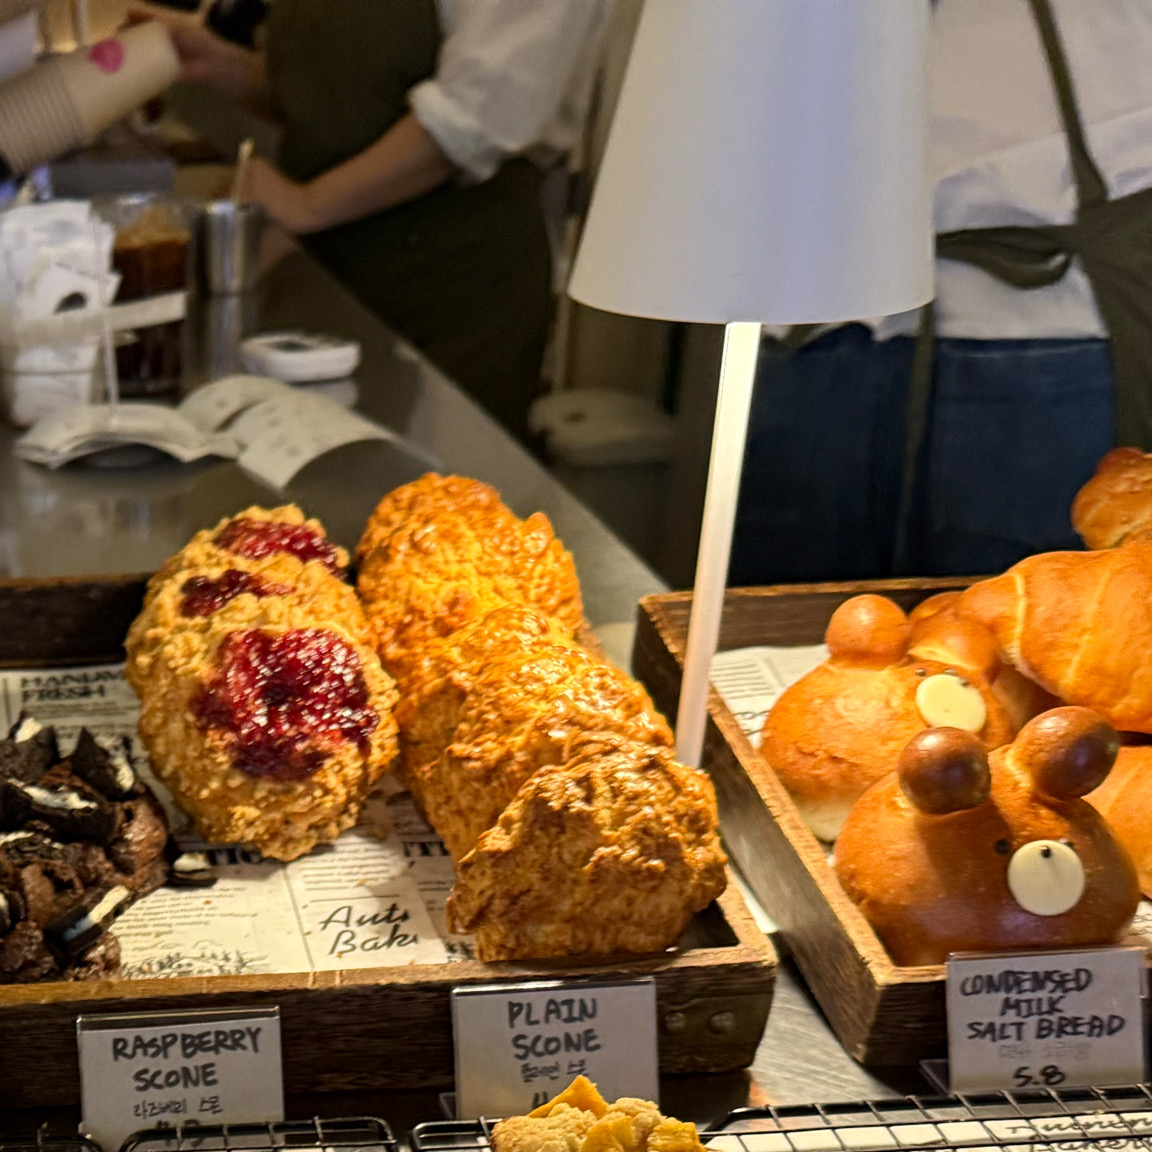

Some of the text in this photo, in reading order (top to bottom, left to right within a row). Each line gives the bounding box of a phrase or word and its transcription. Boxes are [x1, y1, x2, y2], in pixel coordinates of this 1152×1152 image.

[960, 968, 1092, 996] CONDENSED
[508, 998, 597, 1029] PLAIN
[1000, 996, 1066, 1018] MILK
[967, 1014, 1126, 1042] SALT BREAD
[112, 1026, 261, 1061] RASPBERRY
[511, 1028, 601, 1061] SCONE
[133, 1062, 219, 1092] SCONE
[1013, 1065, 1066, 1087] 5.8
